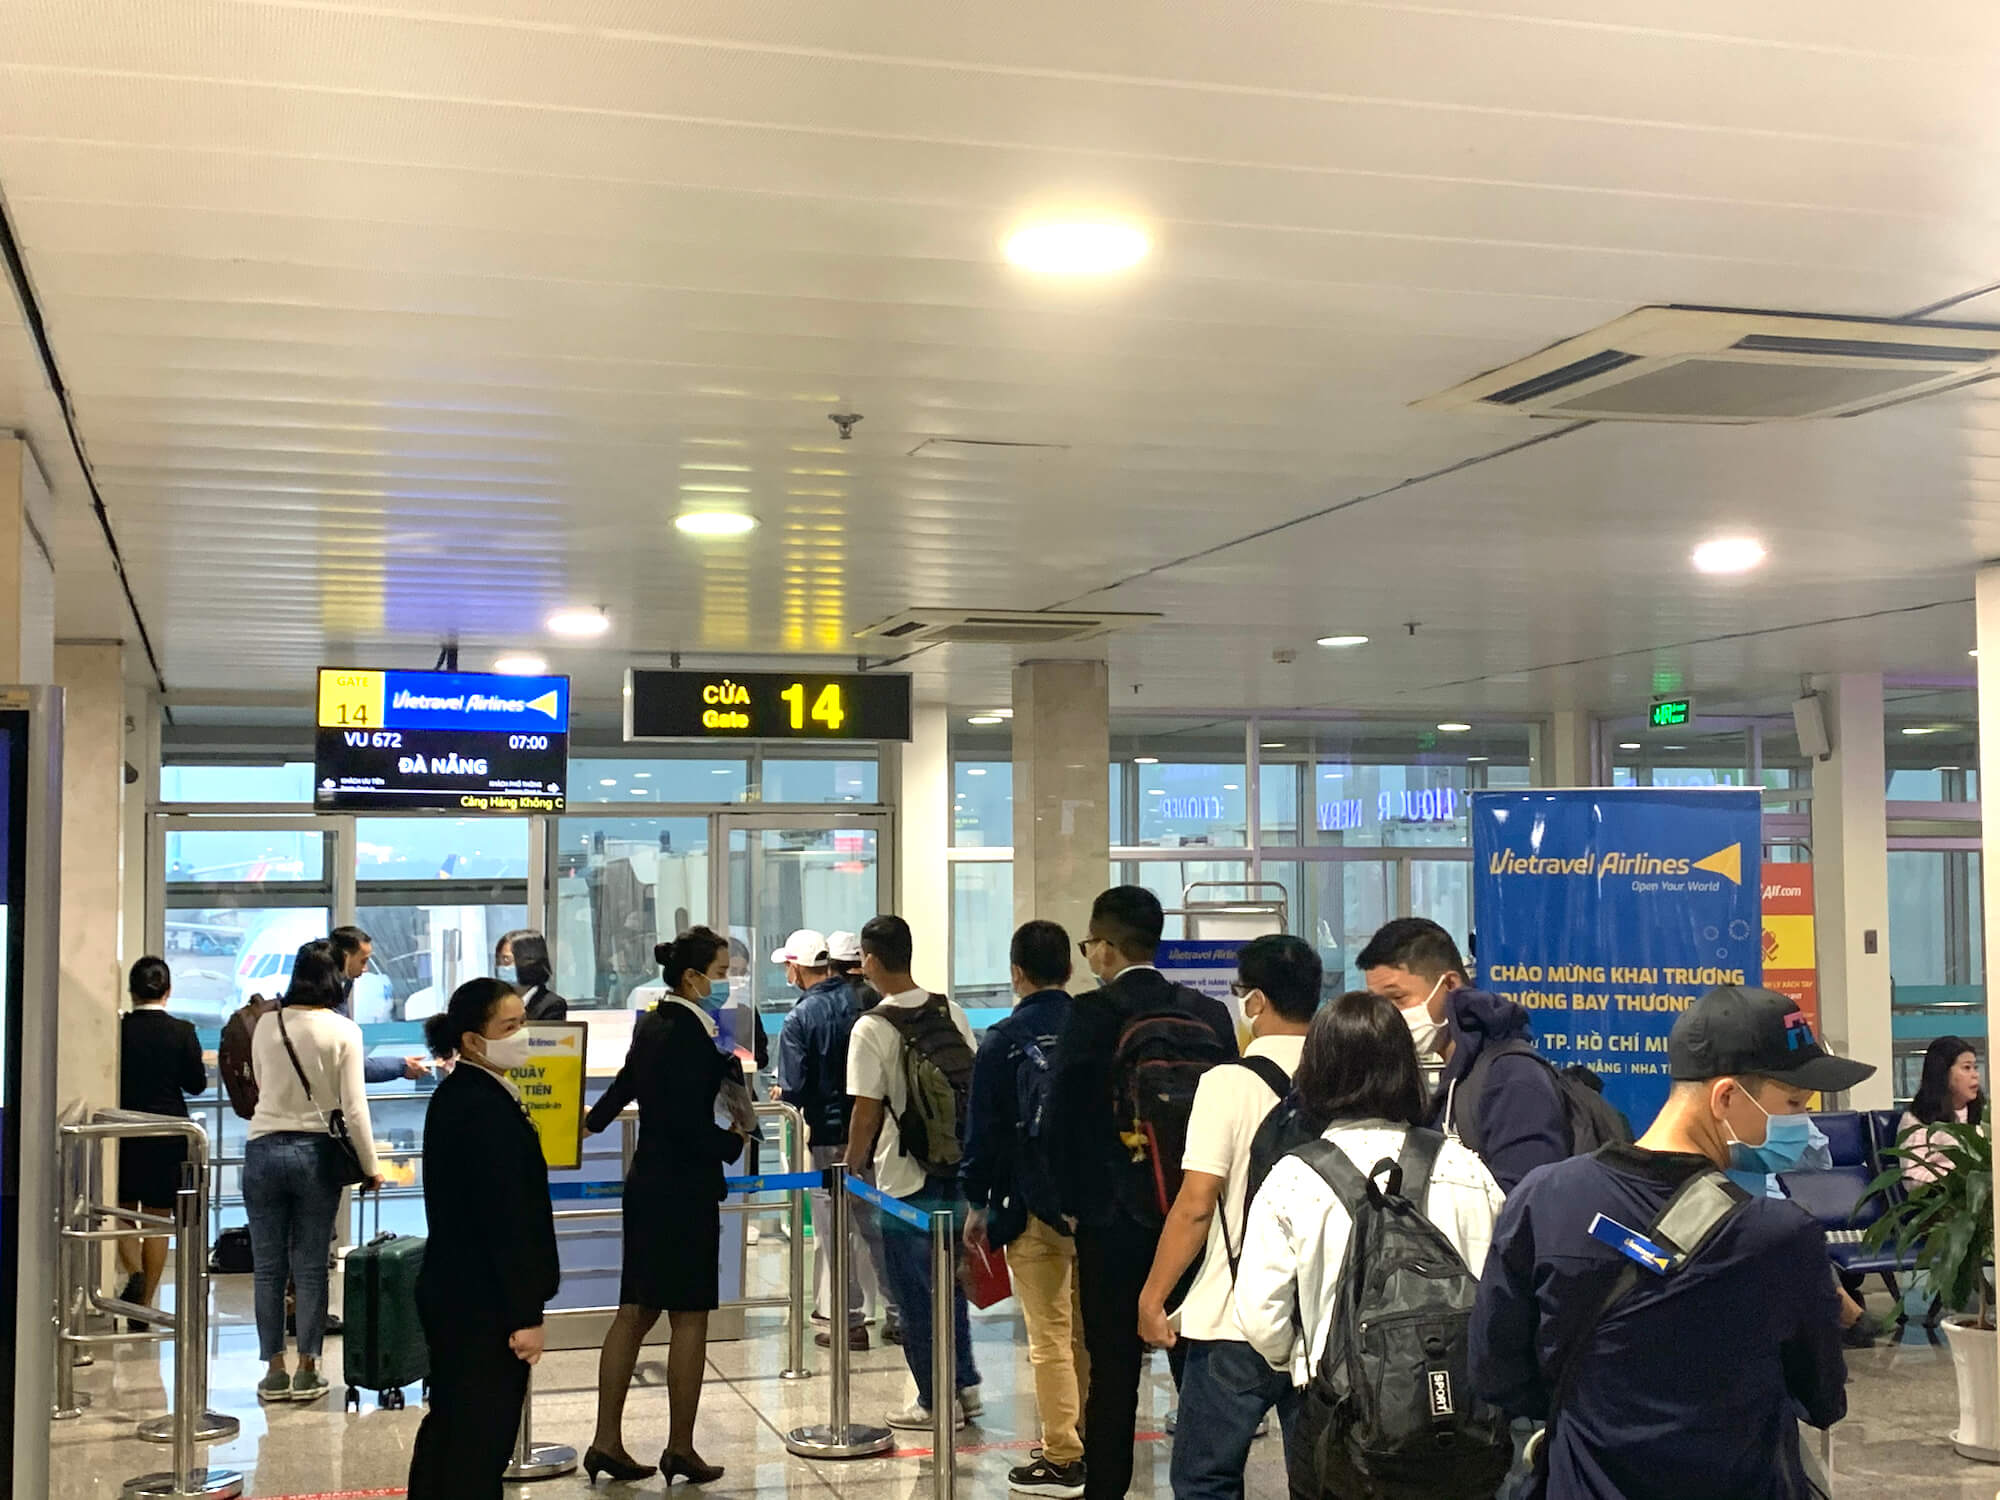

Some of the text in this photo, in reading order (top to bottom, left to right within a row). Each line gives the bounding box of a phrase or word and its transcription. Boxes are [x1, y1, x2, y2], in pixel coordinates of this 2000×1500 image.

[336, 676, 369, 688] GATE
[702, 679, 751, 705] CỬA
[392, 688, 525, 713] Vietravel Airlines
[781, 683, 845, 730] 14
[336, 703, 368, 725] 14
[702, 709, 749, 729] Gate
[344, 731, 402, 749] VU 672
[508, 735, 548, 750] 07:00
[398, 755, 428, 775] ĐÀ
[520, 796, 553, 811] Không
[1490, 847, 1690, 879] Vietravel Airlines
[1631, 880, 1720, 894] Open Your World
[1490, 962, 1745, 986] CHÀO MỪNG KHAI TRƯƠNG
[1572, 994, 1609, 1011] BAY
[1614, 993, 1696, 1013] THƯƠNG
[1543, 1033, 1571, 1050] TP.
[1575, 1030, 1603, 1050] HỒ
[1608, 1032, 1640, 1052] CHÍ
[1631, 1063, 1658, 1074] NHA
[1433, 1373, 1448, 1410] SPORT
